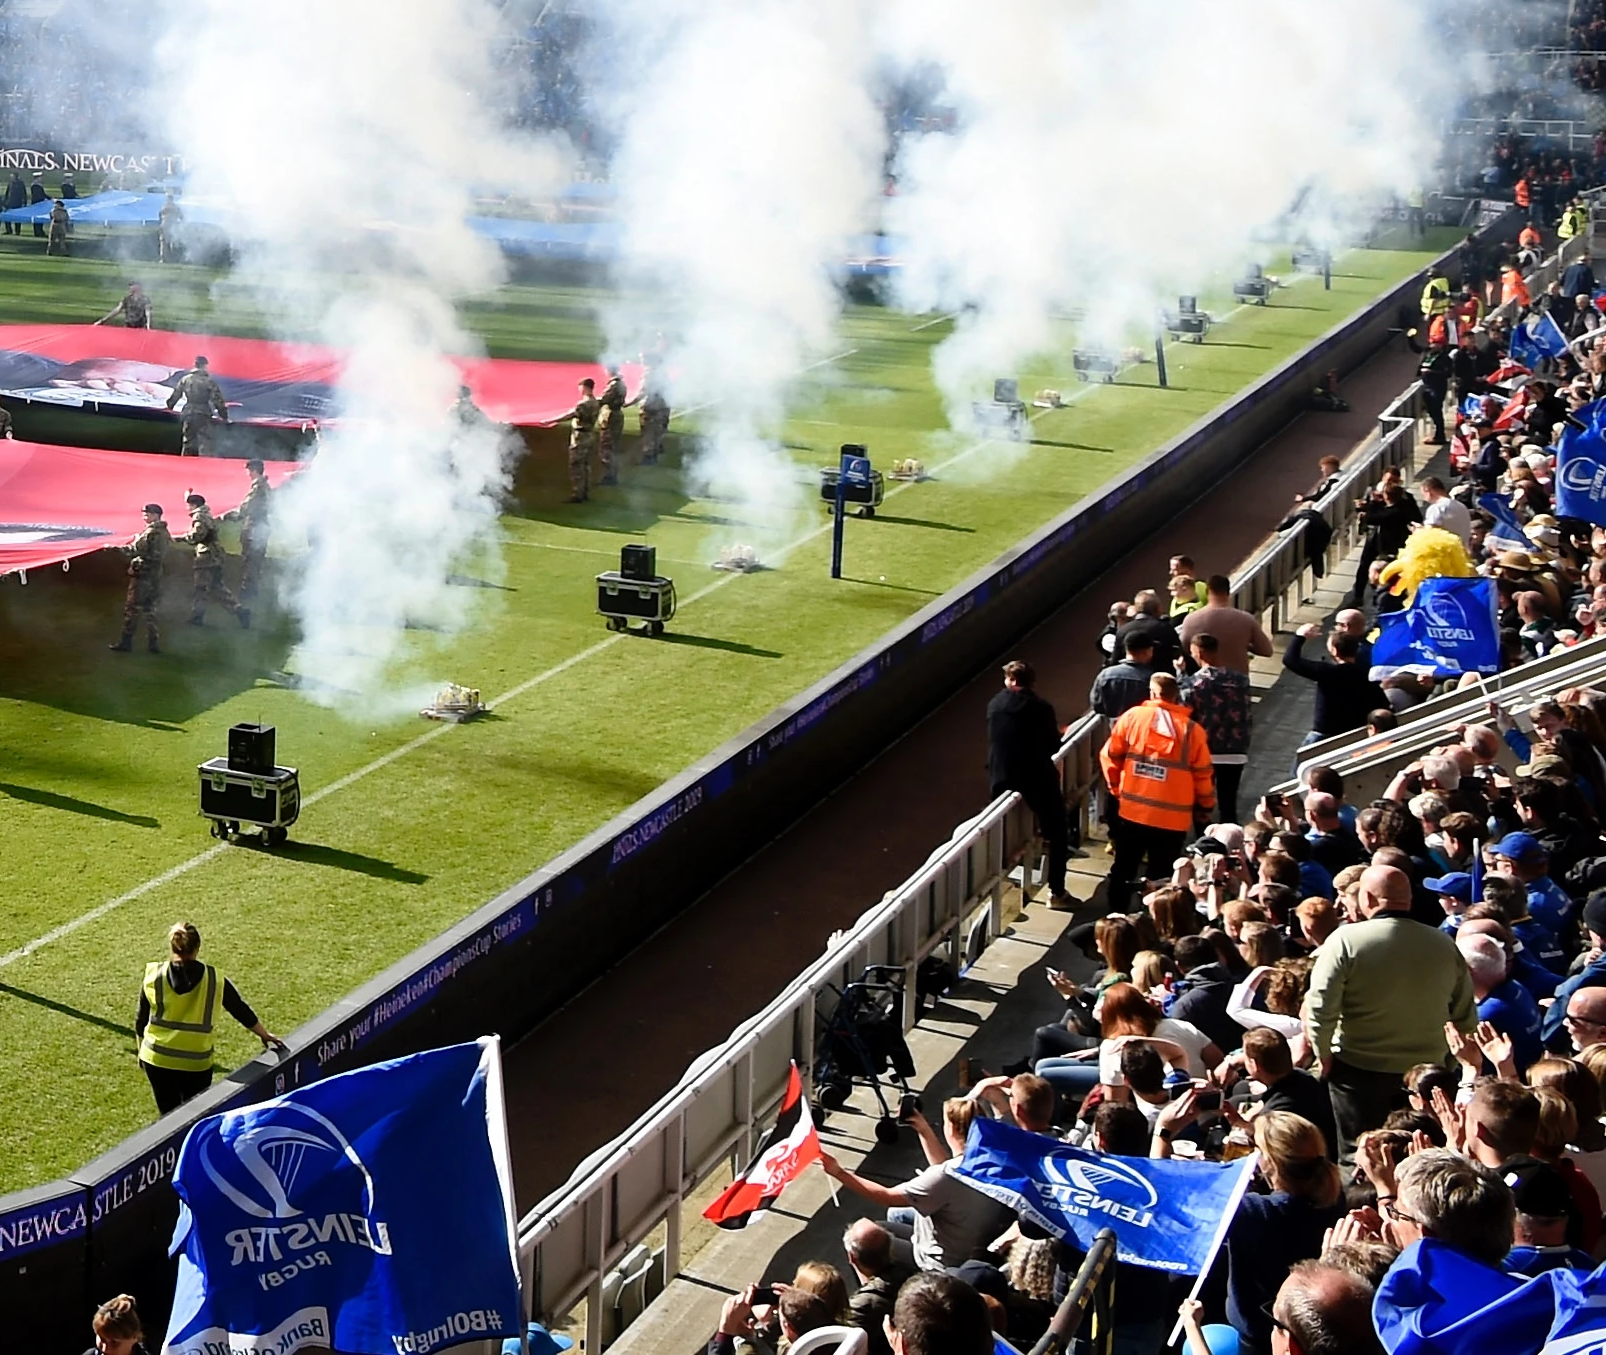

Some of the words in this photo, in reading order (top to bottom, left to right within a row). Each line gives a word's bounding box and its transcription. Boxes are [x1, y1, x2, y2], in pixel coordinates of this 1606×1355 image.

[317, 1034, 346, 1067] Share
[349, 1016, 373, 1050] your
[493, 912, 522, 944] Stories
[137, 1146, 177, 1194] 2019
